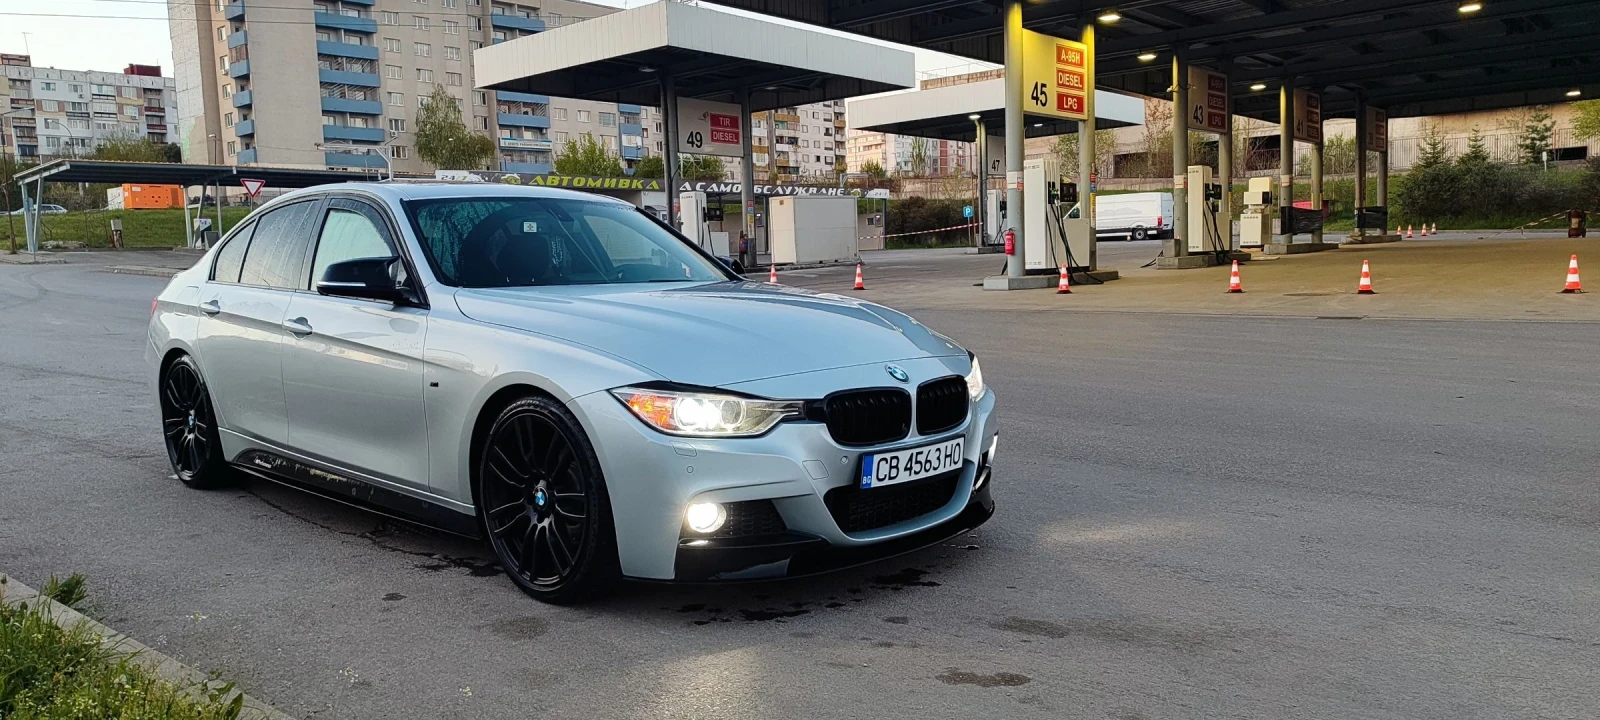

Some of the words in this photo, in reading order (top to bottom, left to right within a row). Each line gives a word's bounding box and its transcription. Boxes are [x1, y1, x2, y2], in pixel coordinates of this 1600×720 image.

[1058, 72, 1083, 88] DIESEL
[1031, 81, 1048, 107] 45
[1063, 96, 1078, 110] LPG
[1209, 96, 1225, 108] DIESEL
[1193, 104, 1204, 124] 43
[1212, 116, 1222, 125] LPG
[719, 117, 731, 126] TIR
[686, 130, 703, 149] 49
[712, 131, 738, 142] DIESEL
[991, 159, 1001, 172] 47
[528, 175, 660, 190] АВТОМИВКА
[876, 456, 900, 482] CB
[904, 448, 941, 476] 4563
[943, 443, 961, 468] HO
[862, 476, 872, 484] BG
